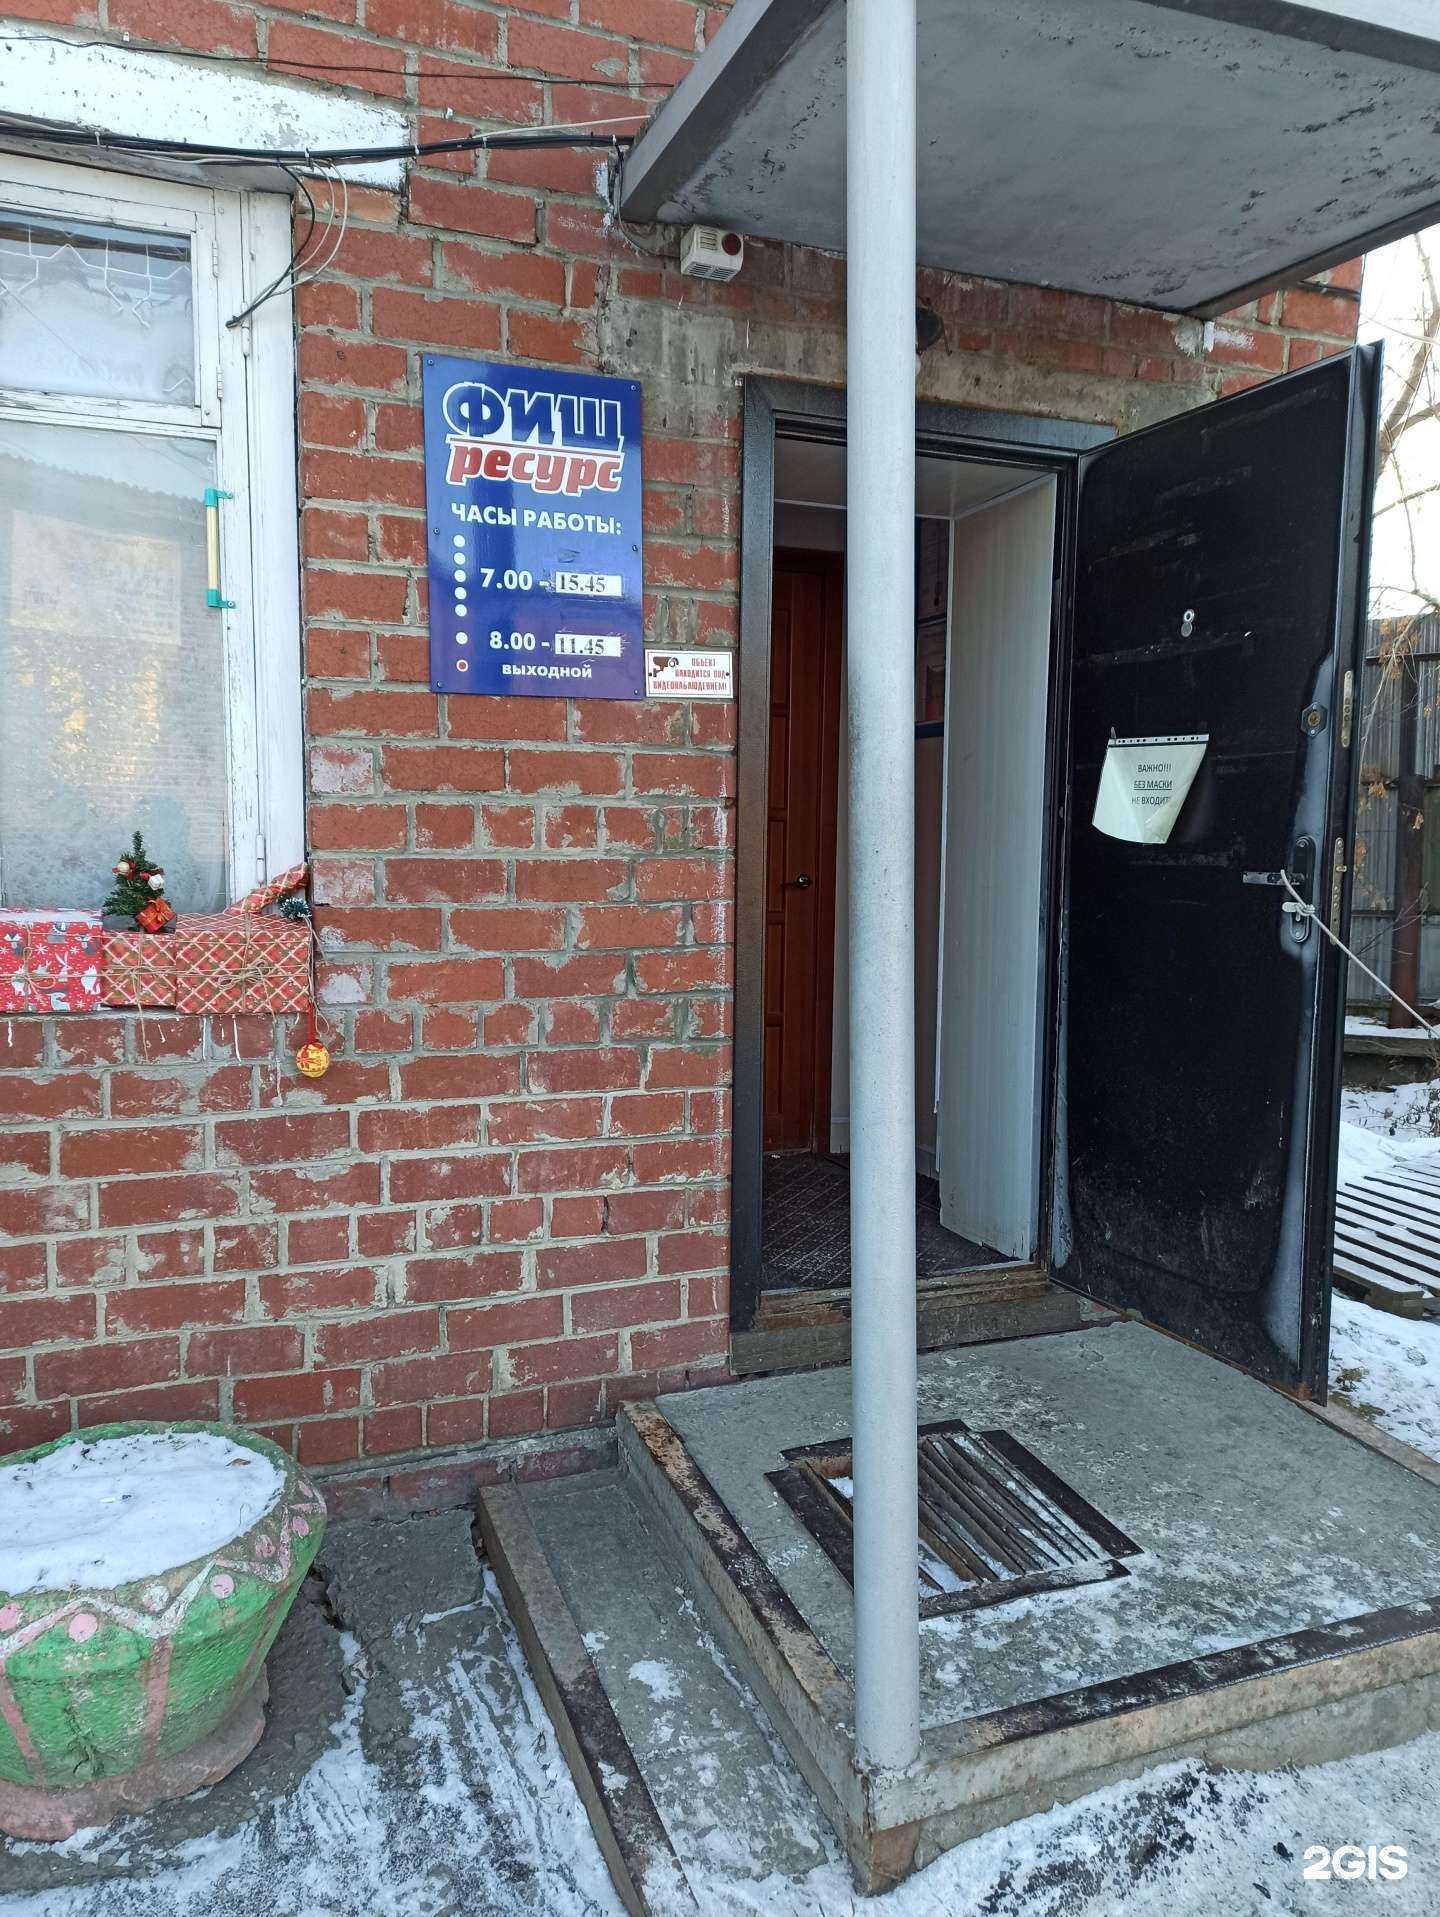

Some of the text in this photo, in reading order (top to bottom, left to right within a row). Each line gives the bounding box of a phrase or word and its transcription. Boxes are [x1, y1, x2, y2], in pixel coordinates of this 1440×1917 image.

[446, 444, 623, 497] ресурс
[451, 502, 623, 535] ЧАСЫ РАБОТЫ:
[480, 567, 533, 591] 7.00
[559, 574, 606, 593] 15.45
[489, 630, 536, 651] 8.00
[559, 637, 605, 655] 11.45
[1133, 780, 1173, 790] БЕЗ МАСКИ
[1131, 796, 1141, 805] НЕ
